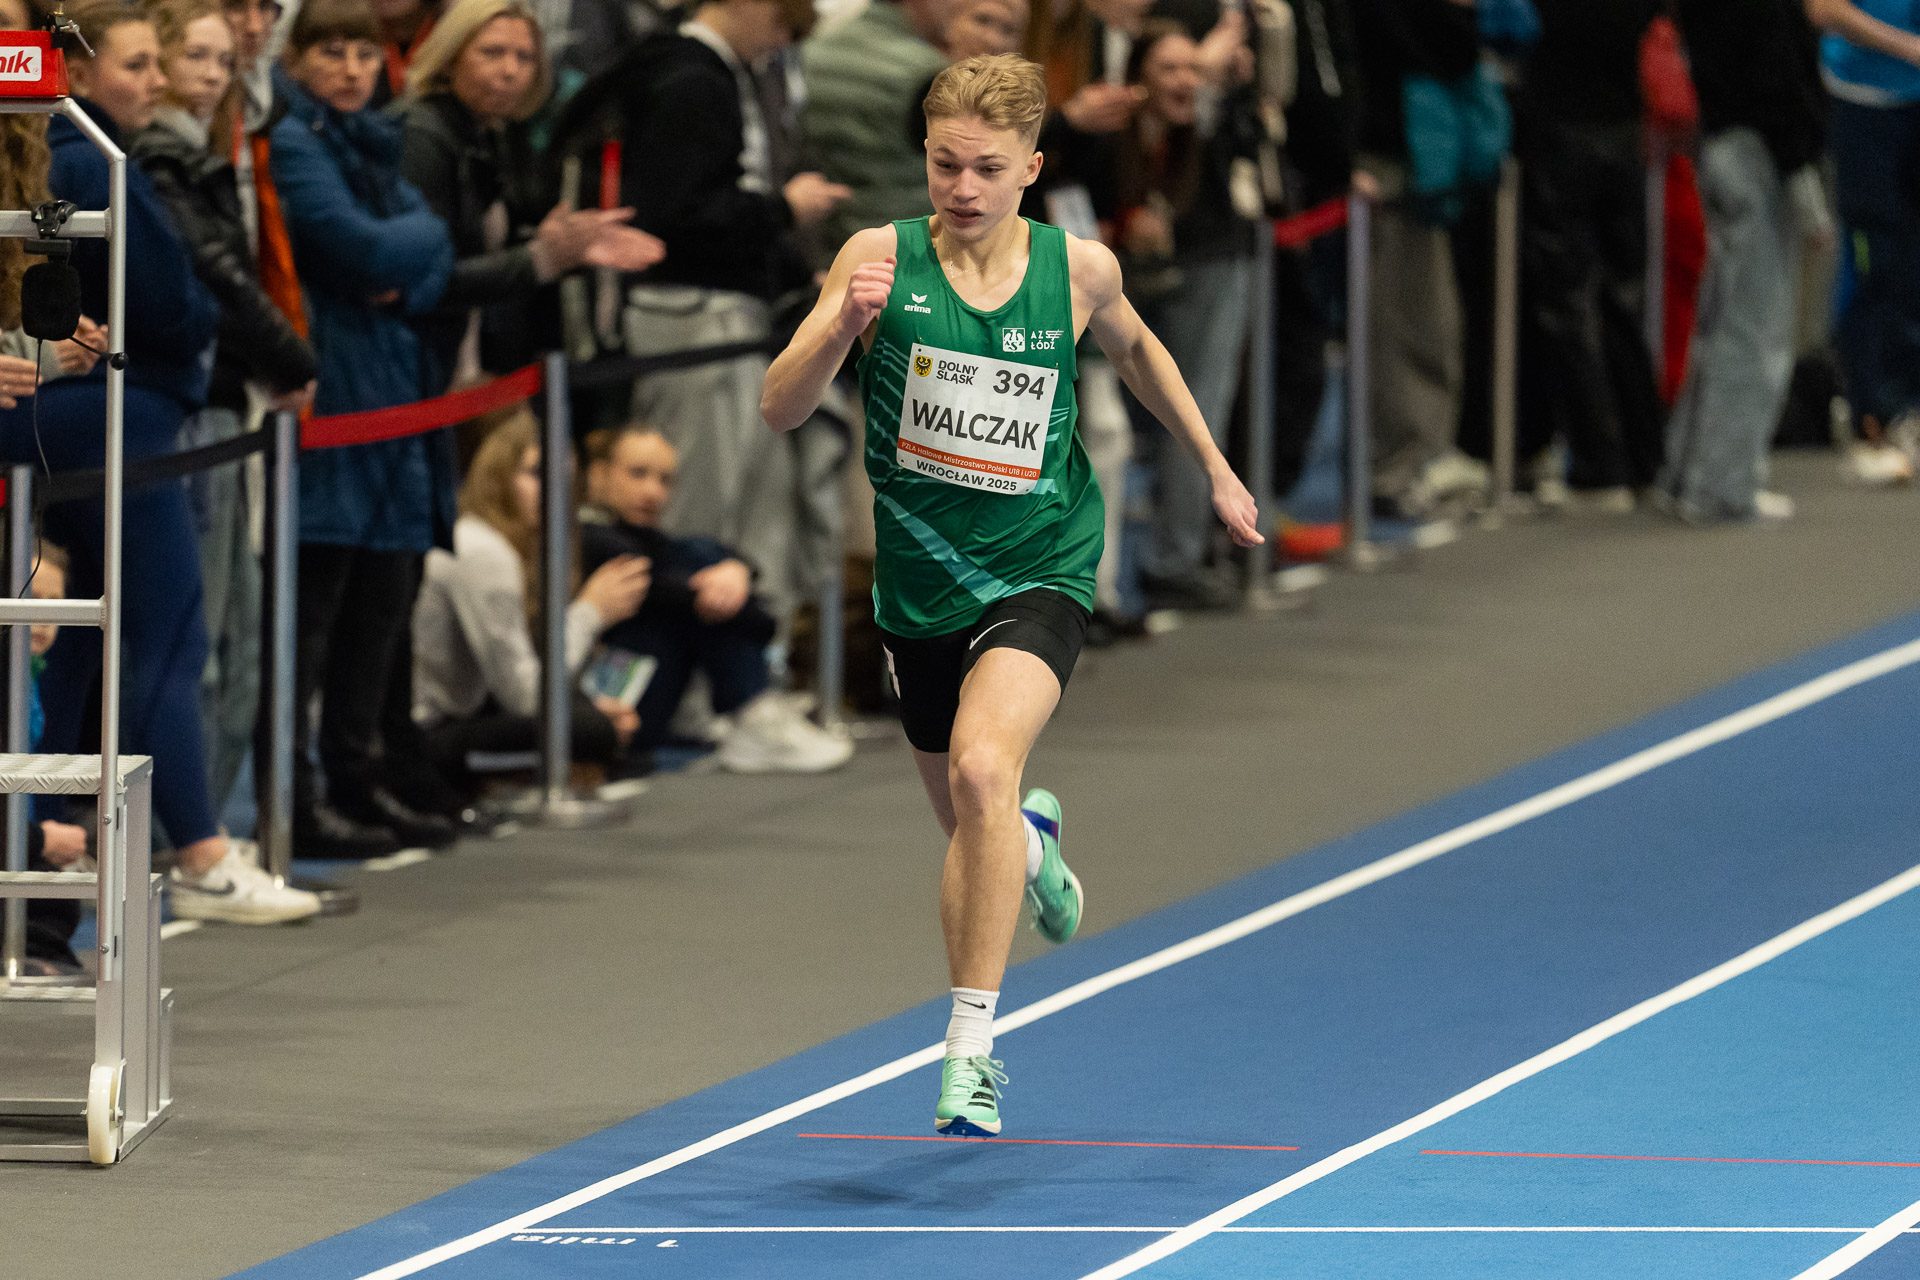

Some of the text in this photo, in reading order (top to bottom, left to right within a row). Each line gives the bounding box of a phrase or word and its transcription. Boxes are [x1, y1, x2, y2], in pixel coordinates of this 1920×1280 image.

[904, 304, 931, 314] erima
[936, 368, 974, 386] ŚLĄSK
[938, 360, 979, 376] DOLNY
[993, 369, 1046, 400] 394
[912, 398, 1040, 451] WALCZAK
[901, 441, 917, 452] PZLA
[917, 447, 942, 461] Halowe
[943, 455, 986, 470] Mistrzostwa
[987, 464, 1008, 474] Polski
[1008, 467, 1021, 476] U18
[916, 459, 1018, 491] WROCŁAW 2025
